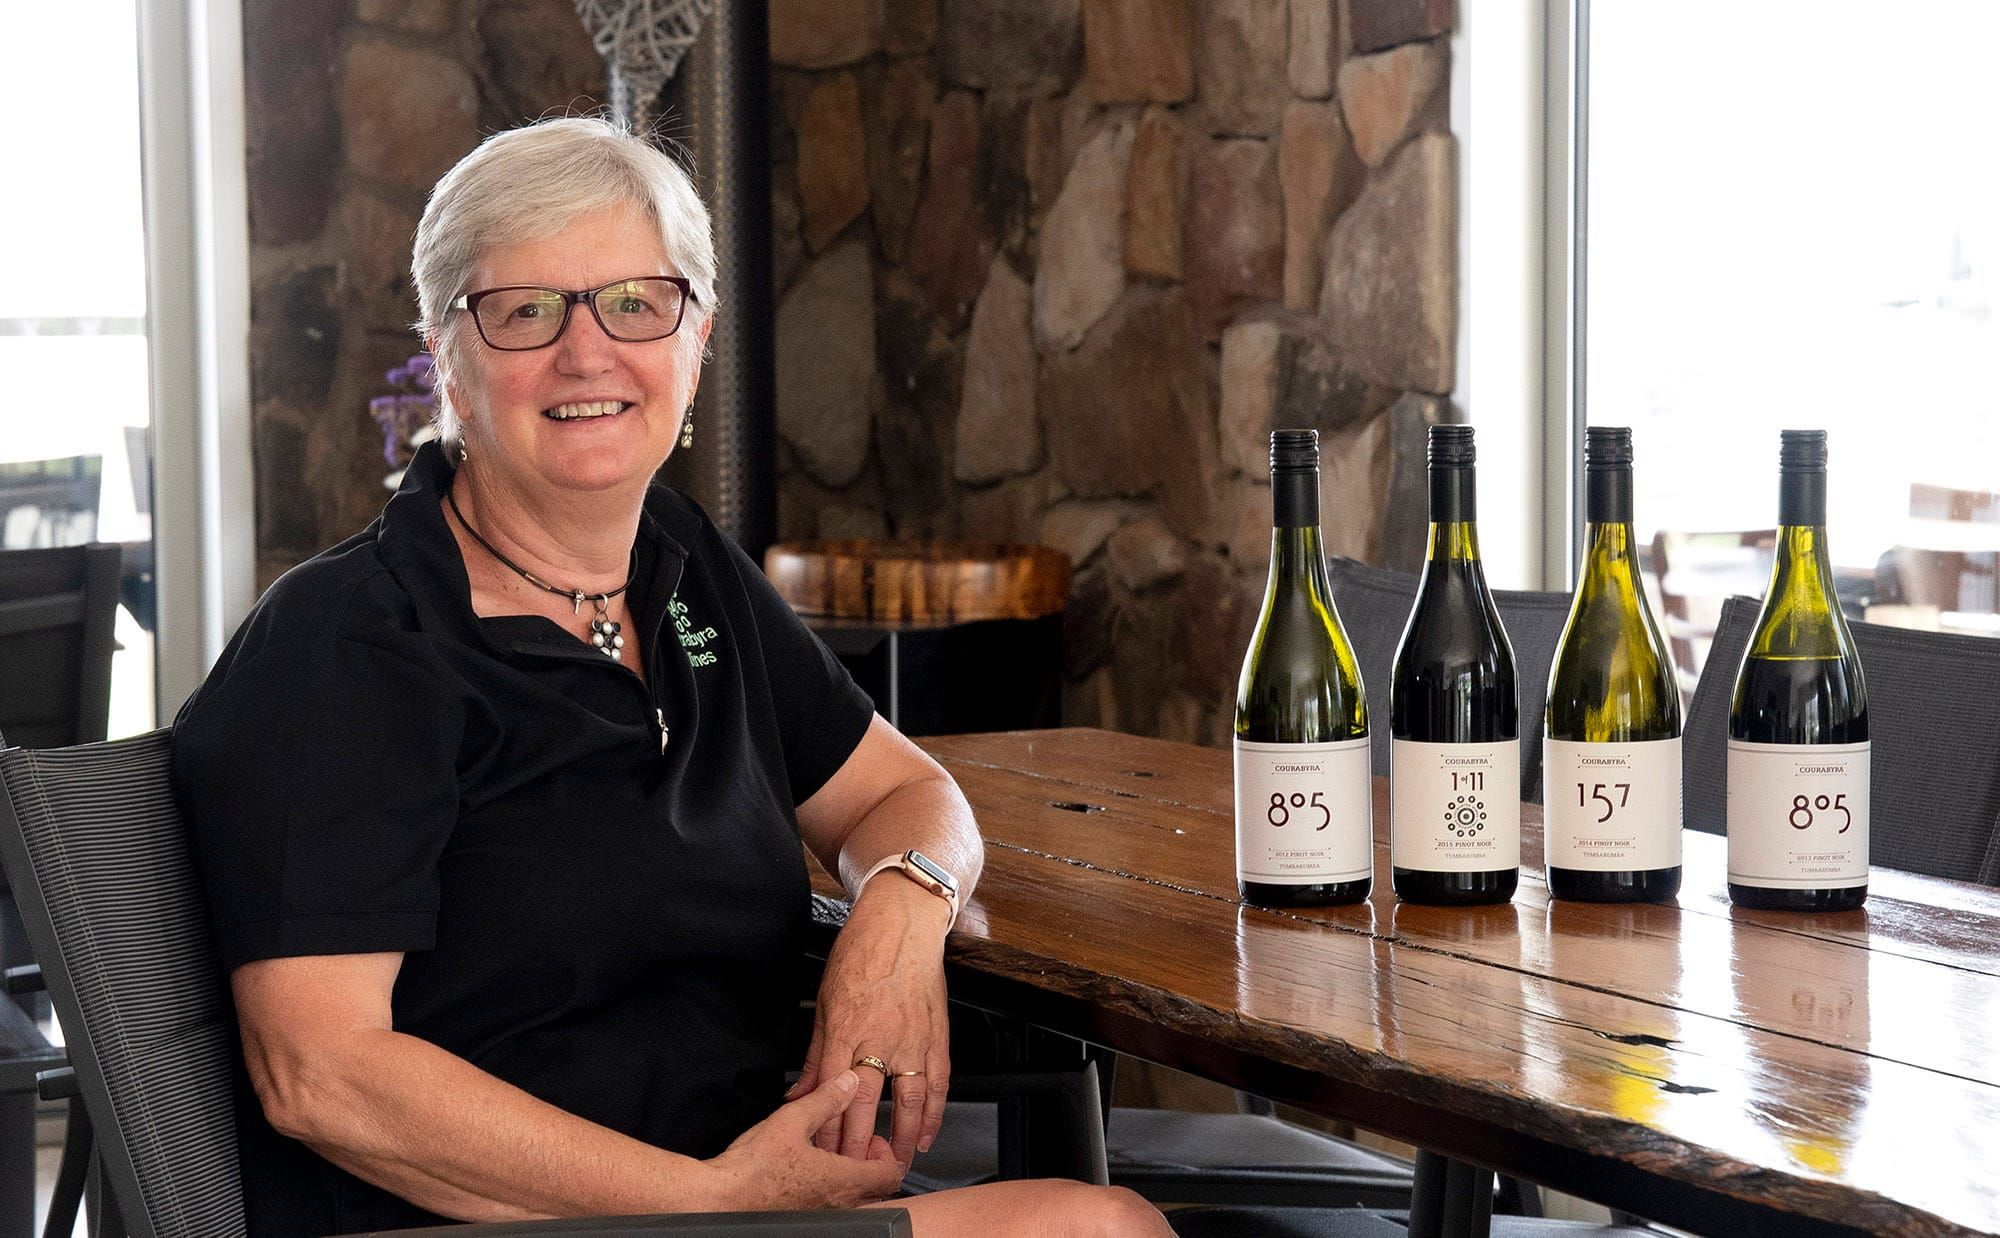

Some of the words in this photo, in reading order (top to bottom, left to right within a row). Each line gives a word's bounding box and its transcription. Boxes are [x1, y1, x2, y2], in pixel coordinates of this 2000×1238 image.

[1451, 772, 1458, 791] 1
[1460, 775, 1469, 784] of
[1469, 772, 1484, 791] 11
[1577, 783, 1631, 823] 157
